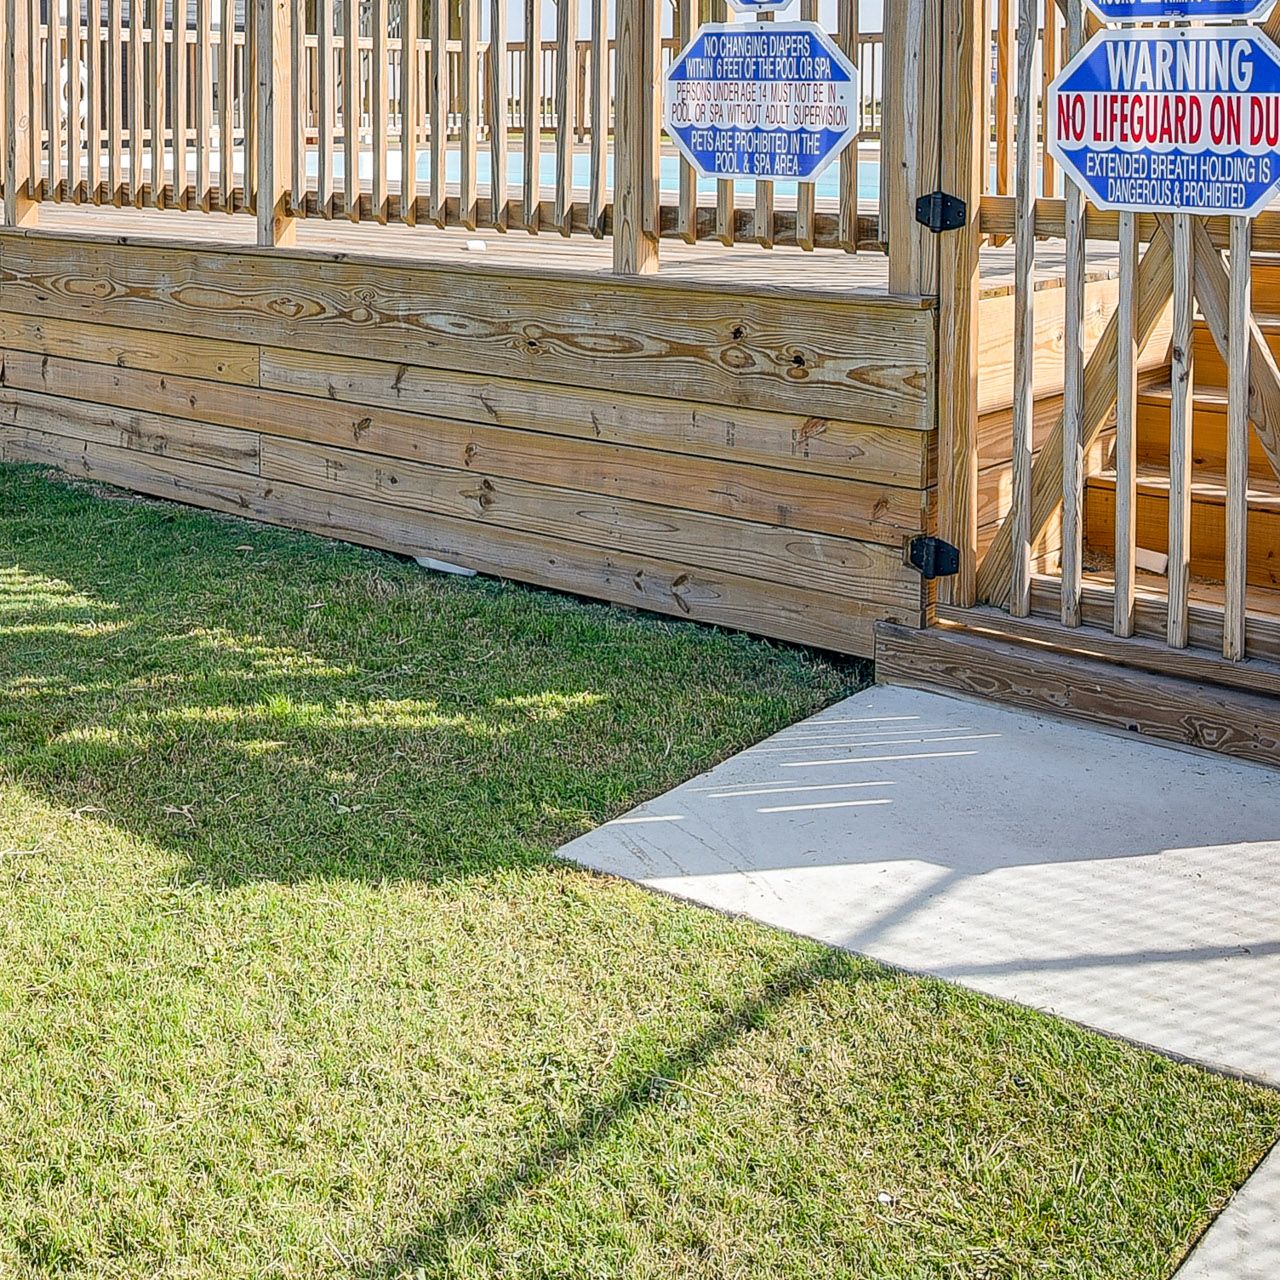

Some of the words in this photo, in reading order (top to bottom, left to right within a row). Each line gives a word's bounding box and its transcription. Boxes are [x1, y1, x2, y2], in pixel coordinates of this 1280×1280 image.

[704, 36, 718, 57] NO
[720, 36, 768, 57] CHANGING
[770, 36, 810, 57] DIAPERS
[686, 58, 713, 78] WITHIN
[717, 58, 721, 78] 6
[723, 58, 744, 78] FEET
[746, 58, 756, 78] OF
[758, 58, 774, 79] THE
[776, 58, 799, 79] POOL
[799, 58, 813, 79] OR
[815, 58, 831, 79] SPA
[1106, 39, 1253, 91] WARNING
[677, 83, 711, 101] PERSONS
[713, 83, 739, 101] UNDER
[741, 83, 756, 102] AGE
[758, 83, 767, 102] 14
[771, 83, 792, 102] MUST
[795, 84, 811, 102] NOT
[813, 84, 823, 102] BE
[828, 84, 836, 103] IN
[672, 103, 691, 121] POOL
[695, 104, 705, 122] OR
[710, 104, 723, 122] SPA
[728, 104, 761, 123] WITHOUT
[766, 105, 791, 124] ADULT
[794, 105, 847, 126] SUPERVISION
[1058, 94, 1086, 141] NO
[1093, 94, 1202, 144] LIFEGUARD
[1209, 96, 1241, 146] ON
[691, 130, 713, 151] PETS
[714, 131, 733, 151] ARE
[735, 132, 788, 153] PROHIBITED
[790, 133, 799, 154] IN
[801, 134, 820, 154] THE
[715, 153, 739, 172] POOL
[743, 154, 750, 173] &
[754, 154, 770, 174] SPA
[1086, 153, 1147, 178] EXTENDED
[1151, 154, 1196, 180] BREATH
[1200, 156, 1255, 183] HOLDING
[1259, 157, 1270, 183] IS
[1108, 179, 1171, 205] DANGEROUS
[1174, 182, 1180, 206] &
[1183, 182, 1245, 208] PROHIBITED
